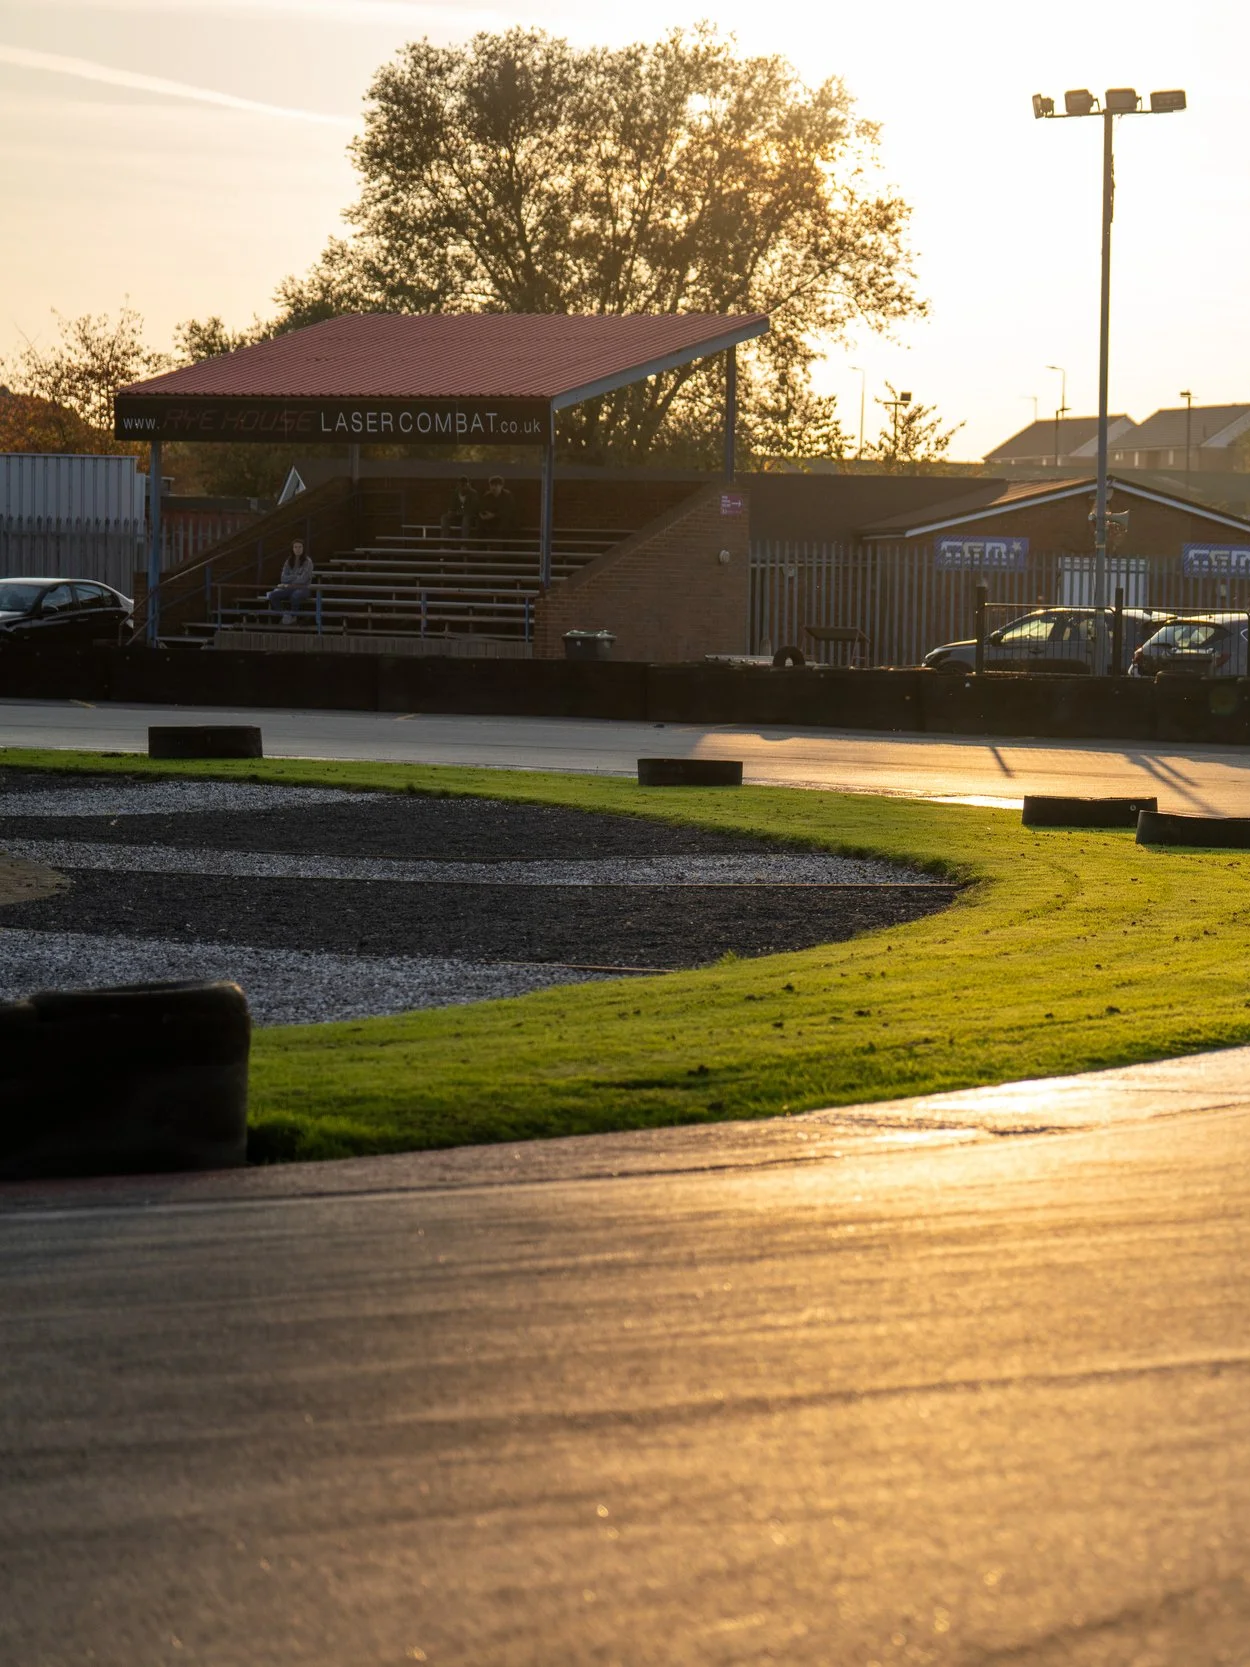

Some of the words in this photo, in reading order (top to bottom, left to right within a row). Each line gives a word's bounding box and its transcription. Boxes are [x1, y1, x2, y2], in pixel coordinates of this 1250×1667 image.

[122, 417, 160, 430] www.
[163, 409, 218, 431] RYE
[220, 410, 316, 432] HOUSE
